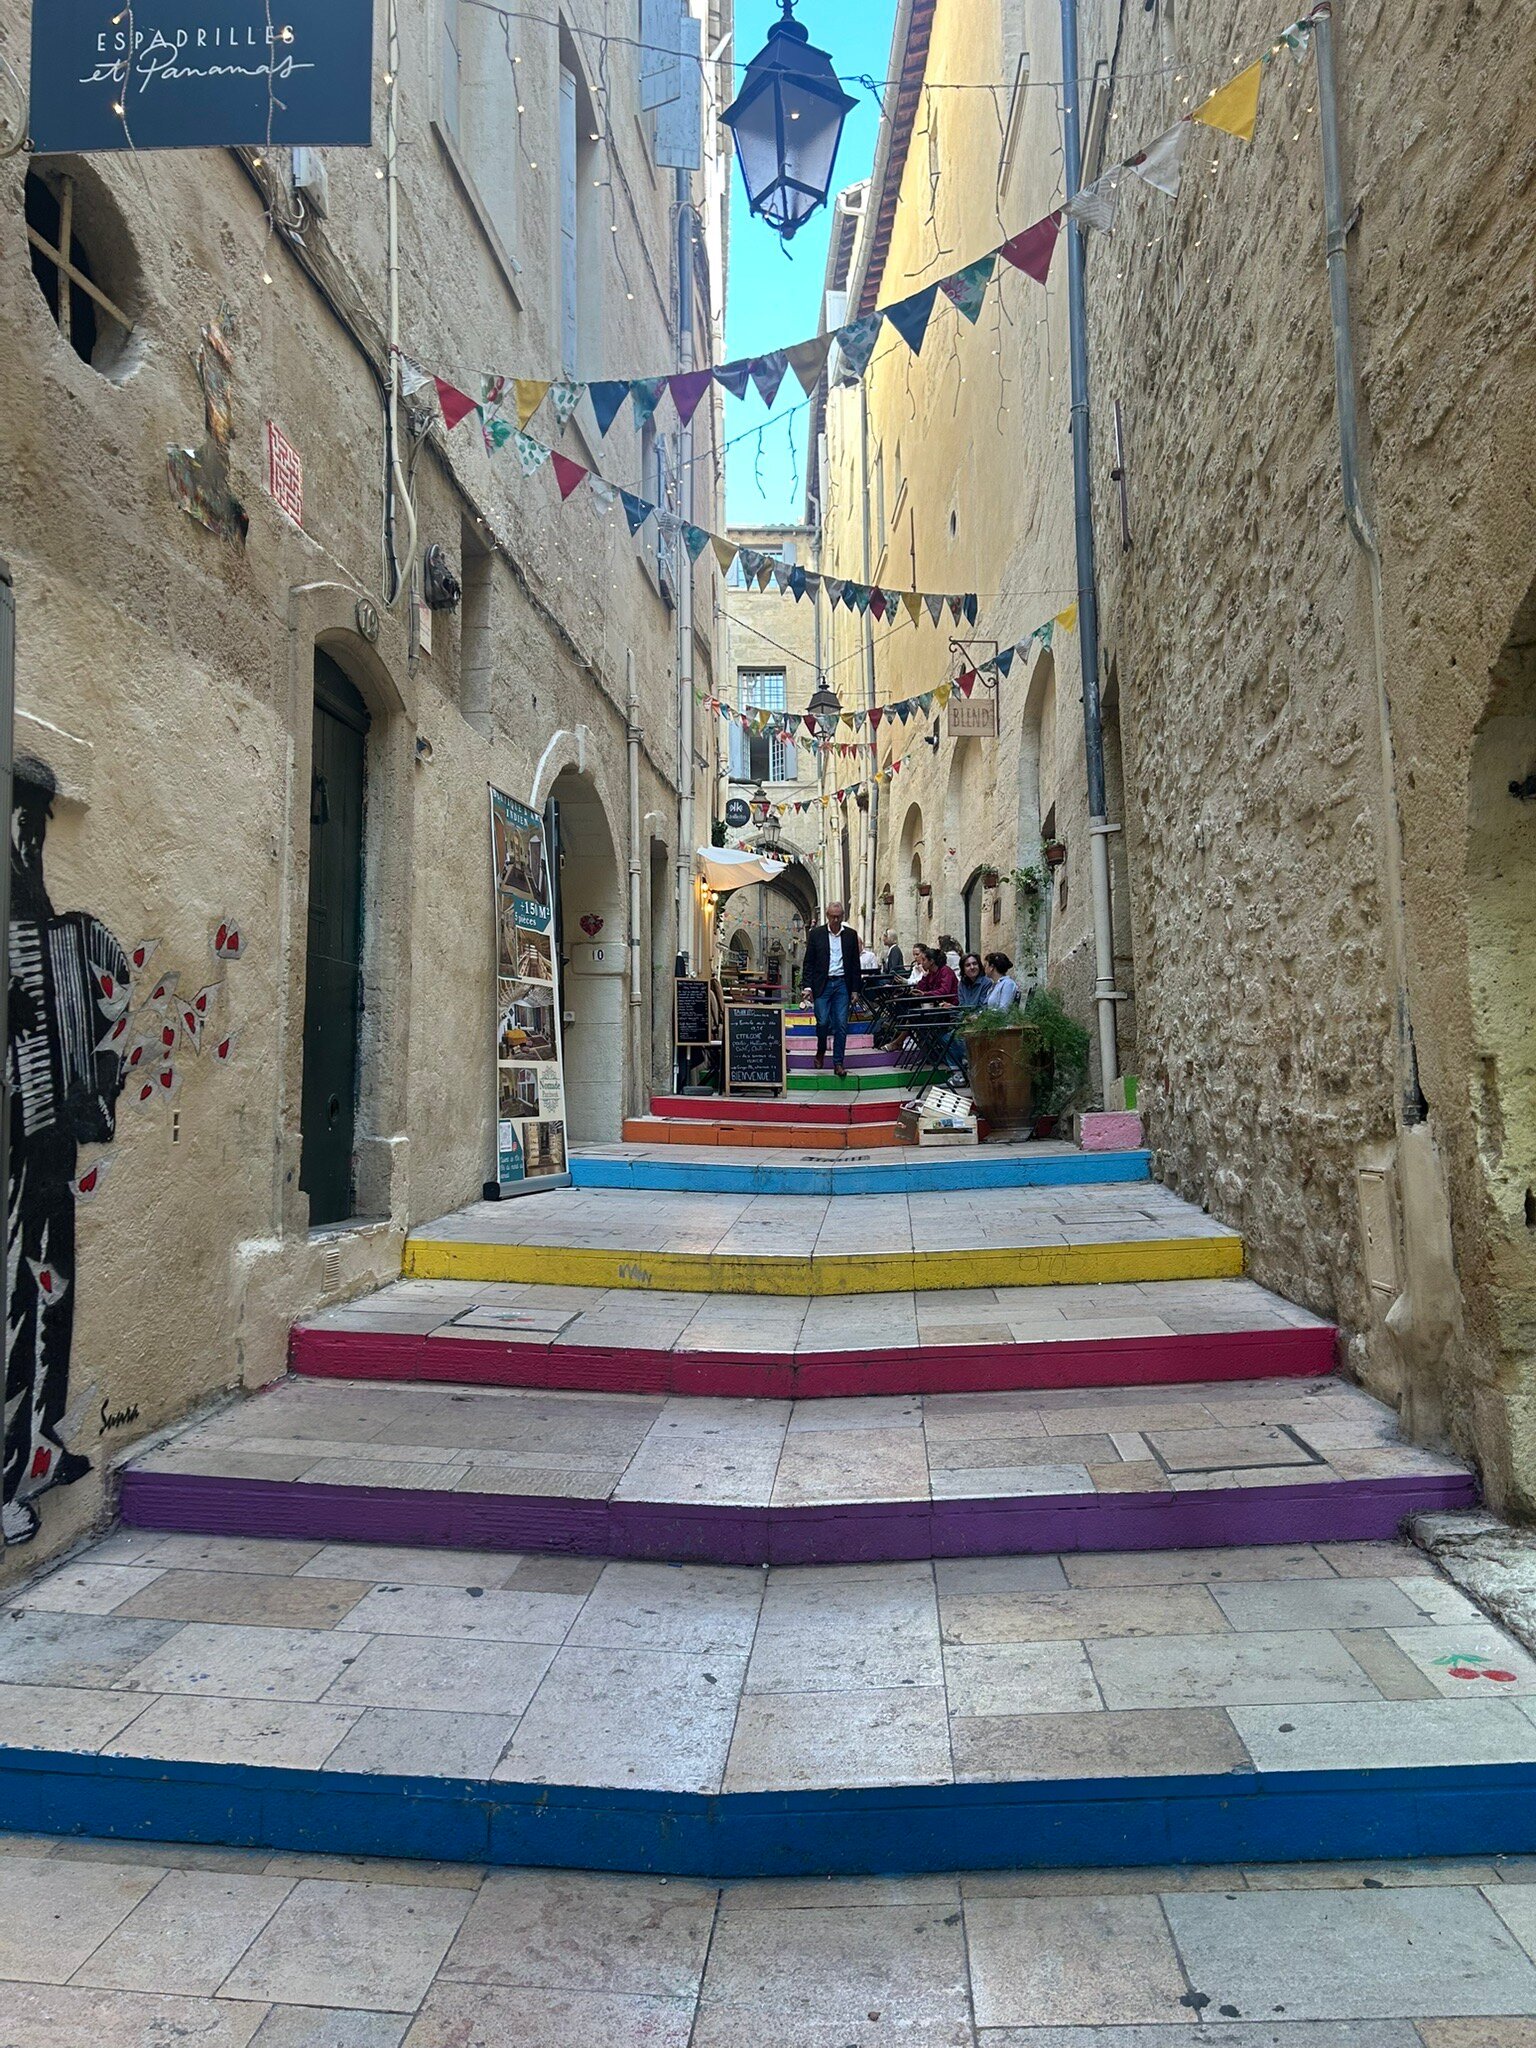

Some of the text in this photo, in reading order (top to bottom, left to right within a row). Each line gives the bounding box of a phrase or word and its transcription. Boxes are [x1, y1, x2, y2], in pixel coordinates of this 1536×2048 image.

[98, 25, 294, 52] ESPADRILLES
[79, 42, 315, 94] et Panamas
[953, 707, 989, 728] BLEND
